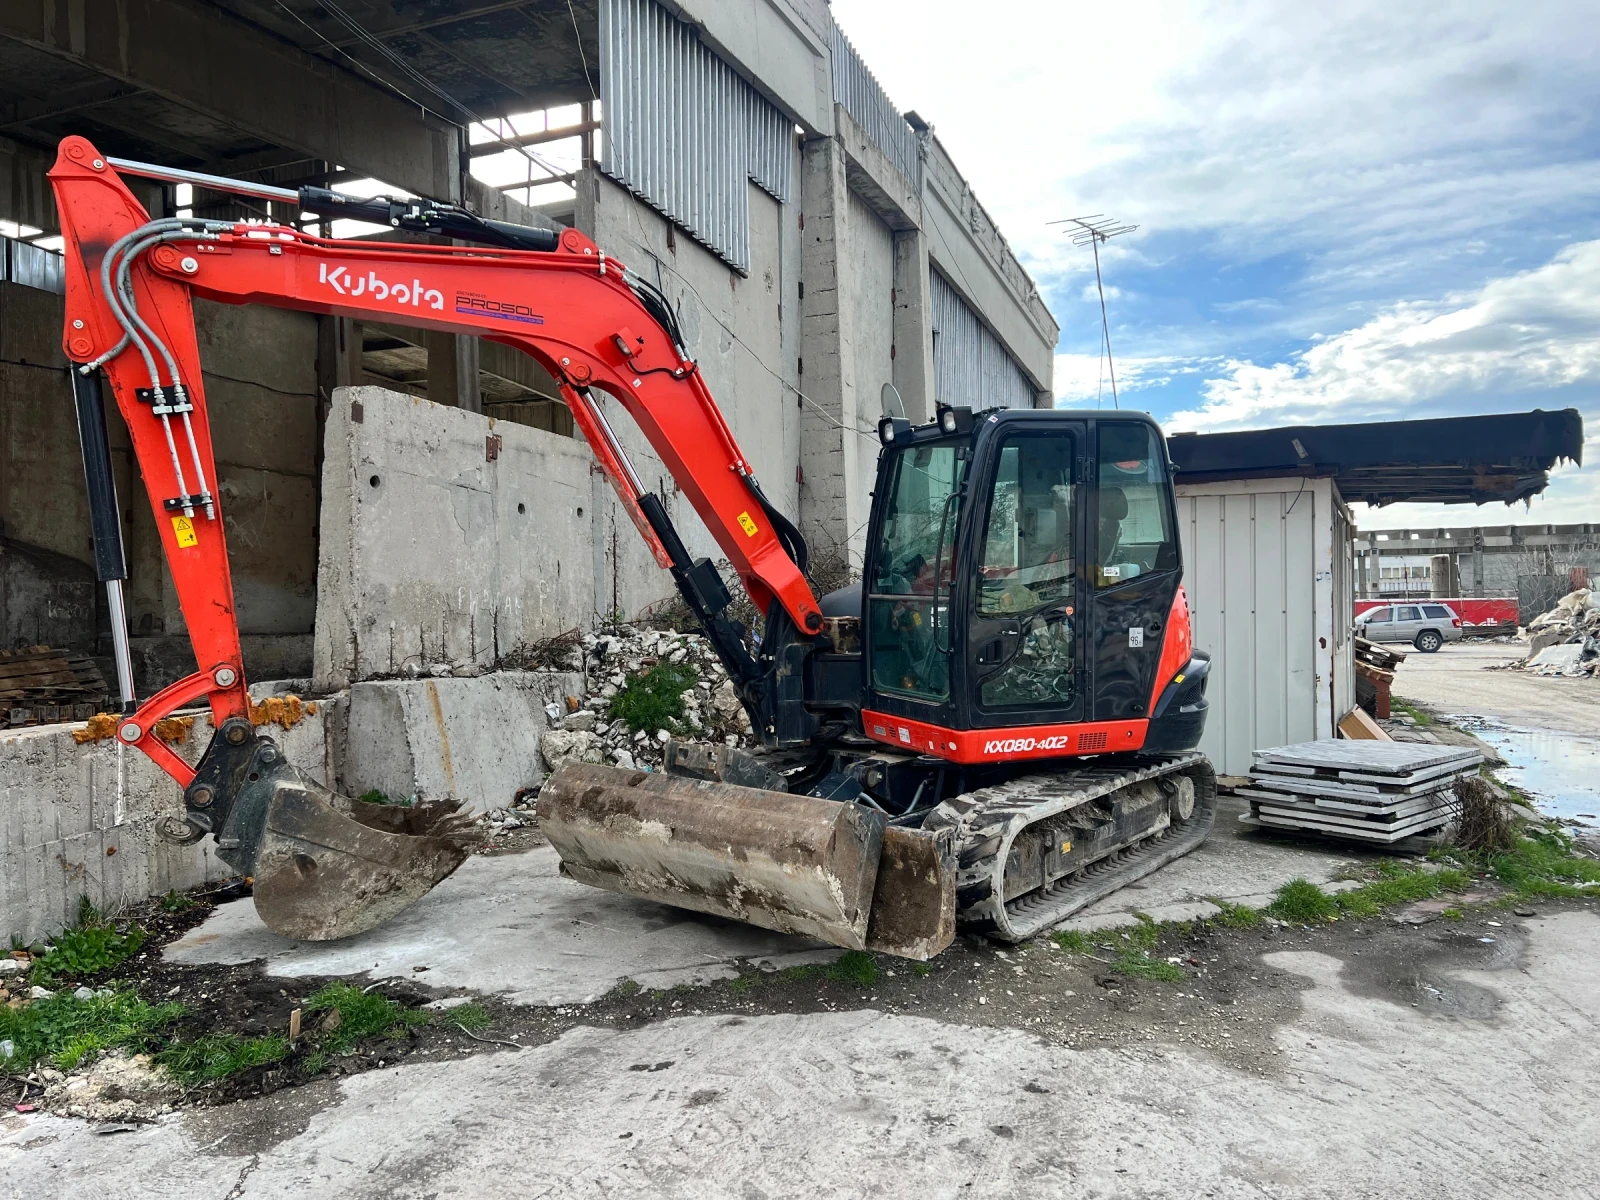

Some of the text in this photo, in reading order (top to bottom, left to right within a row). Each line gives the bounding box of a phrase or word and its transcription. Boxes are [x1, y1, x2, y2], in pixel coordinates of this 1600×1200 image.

[319, 263, 444, 310] Kubota
[456, 296, 544, 318] PROSOL
[1130, 635, 1139, 646] 96
